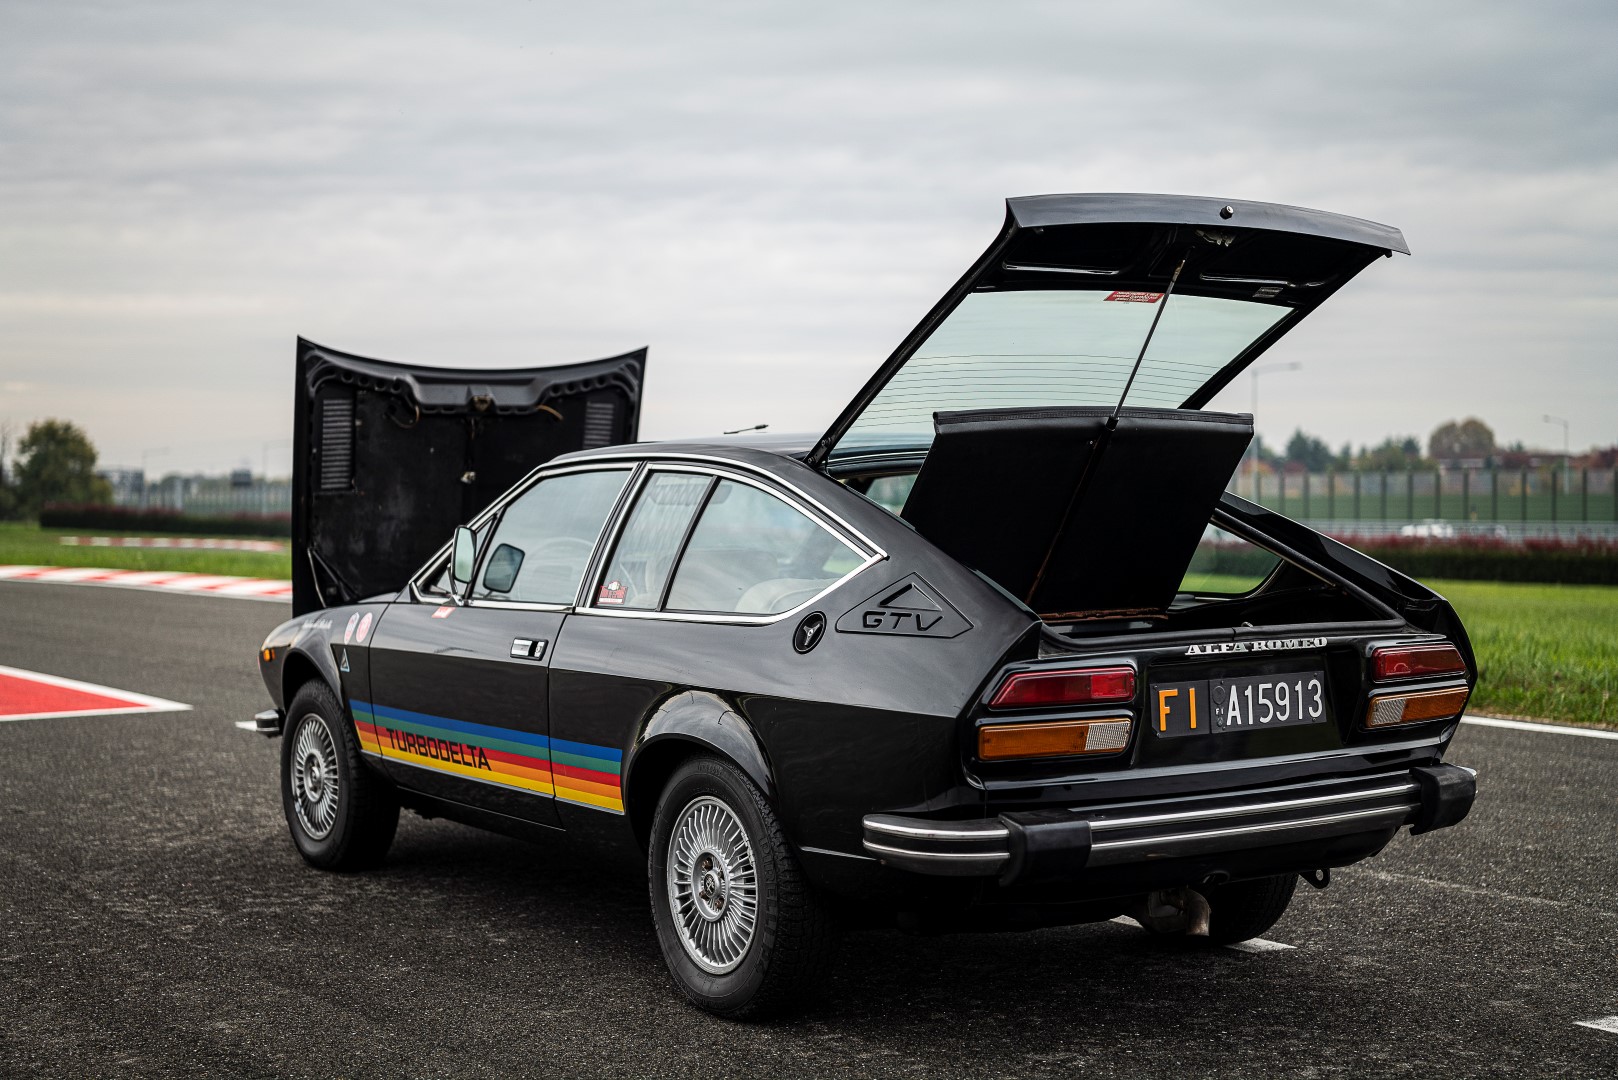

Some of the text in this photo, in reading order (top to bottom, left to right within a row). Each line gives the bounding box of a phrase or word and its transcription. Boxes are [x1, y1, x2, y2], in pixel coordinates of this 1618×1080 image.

[862, 611, 944, 632] GTV
[1184, 636, 1328, 656] ALFA ROMEO
[1158, 679, 1323, 732] FI A15913
[385, 727, 493, 772] TURBODELTA
[758, 836, 778, 936] PIRELLI
